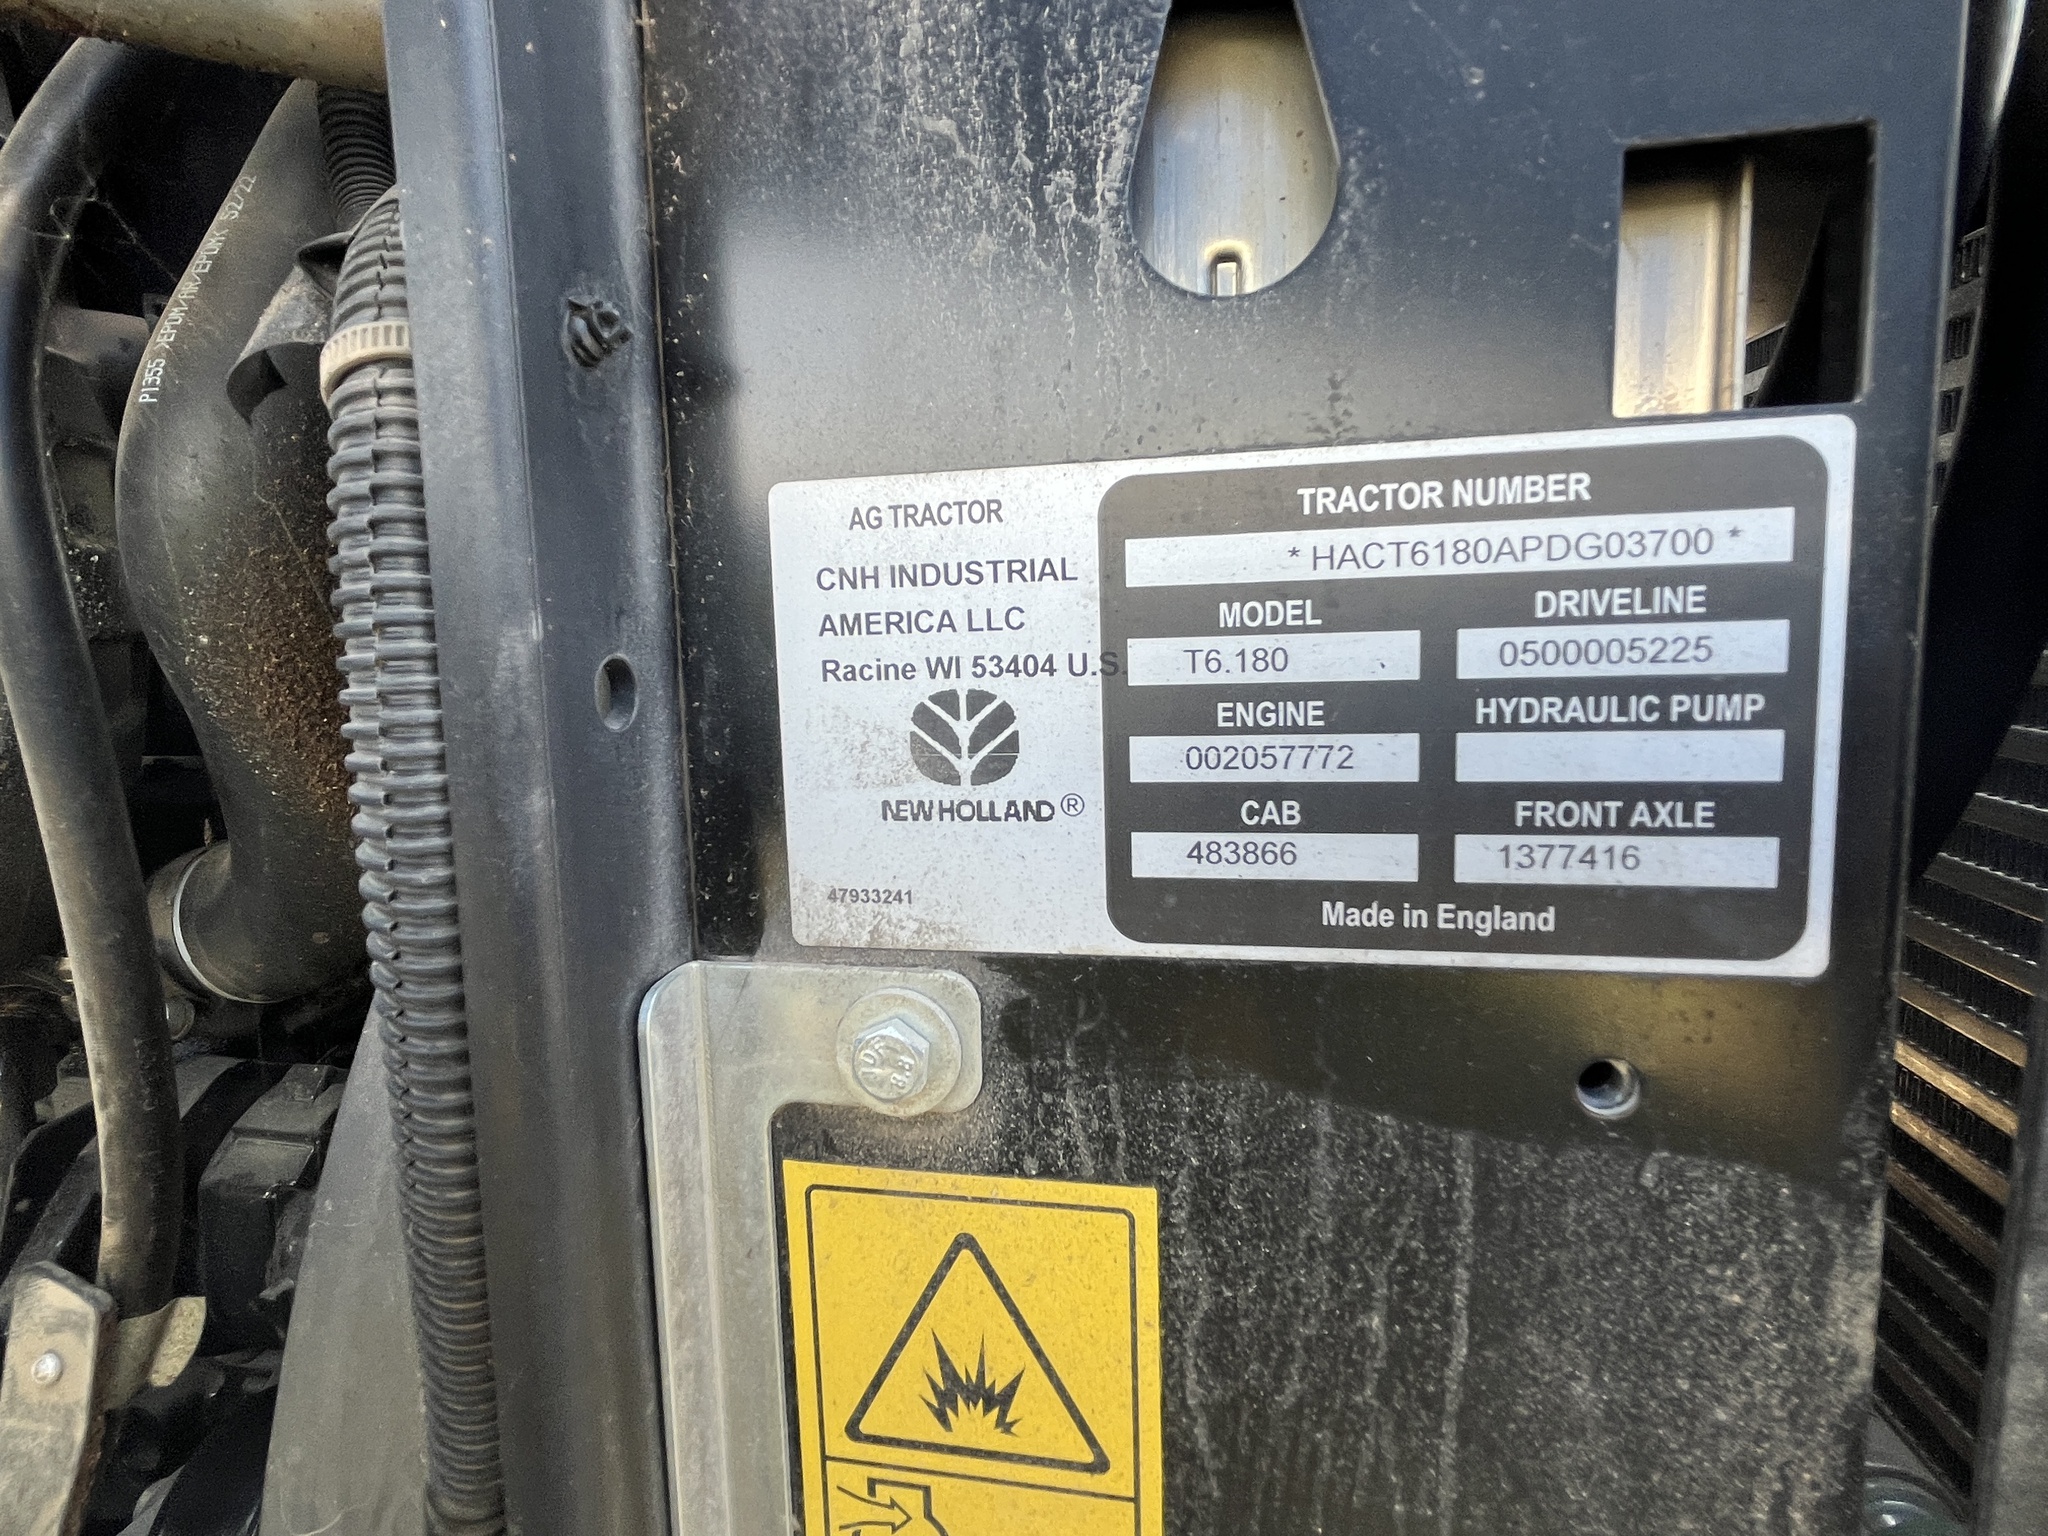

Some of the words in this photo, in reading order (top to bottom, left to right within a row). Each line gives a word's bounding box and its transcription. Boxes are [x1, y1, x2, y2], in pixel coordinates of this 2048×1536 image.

[138, 357, 166, 403] P1355
[1297, 480, 1445, 515] TRACTOR
[1452, 472, 1591, 507] NUMBER
[849, 506, 883, 531] AG
[889, 499, 1003, 528] TRACTOR
[816, 565, 879, 591] CNH
[890, 557, 1079, 588] INDUSTRIAL
[1219, 599, 1323, 628] MODEL
[1534, 585, 1707, 619] DRIVELINE
[818, 609, 958, 637] AMERICA
[967, 606, 1026, 632] LLC
[1184, 647, 1289, 675] T6.180
[1499, 635, 1714, 667] 0500005225
[821, 658, 917, 682] Racine
[925, 656, 962, 680] WI
[971, 654, 1057, 678] 53404
[1217, 700, 1325, 728] ENGINE
[1475, 696, 1660, 724] HYDRAULIC
[1670, 694, 1766, 722] PUMP
[1185, 744, 1355, 771] 002057772
[881, 799, 934, 822] NEW
[938, 799, 1056, 822] HOLLAND
[1240, 799, 1302, 826] CAB
[1515, 800, 1623, 828] FRONT
[1630, 801, 1716, 829] AXLE
[1186, 840, 1298, 866] 483866
[1498, 844, 1641, 871] 1377416
[828, 888, 913, 905] 47933241
[1322, 900, 1395, 928] Made
[1403, 903, 1428, 929] in
[1437, 904, 1556, 937] England
